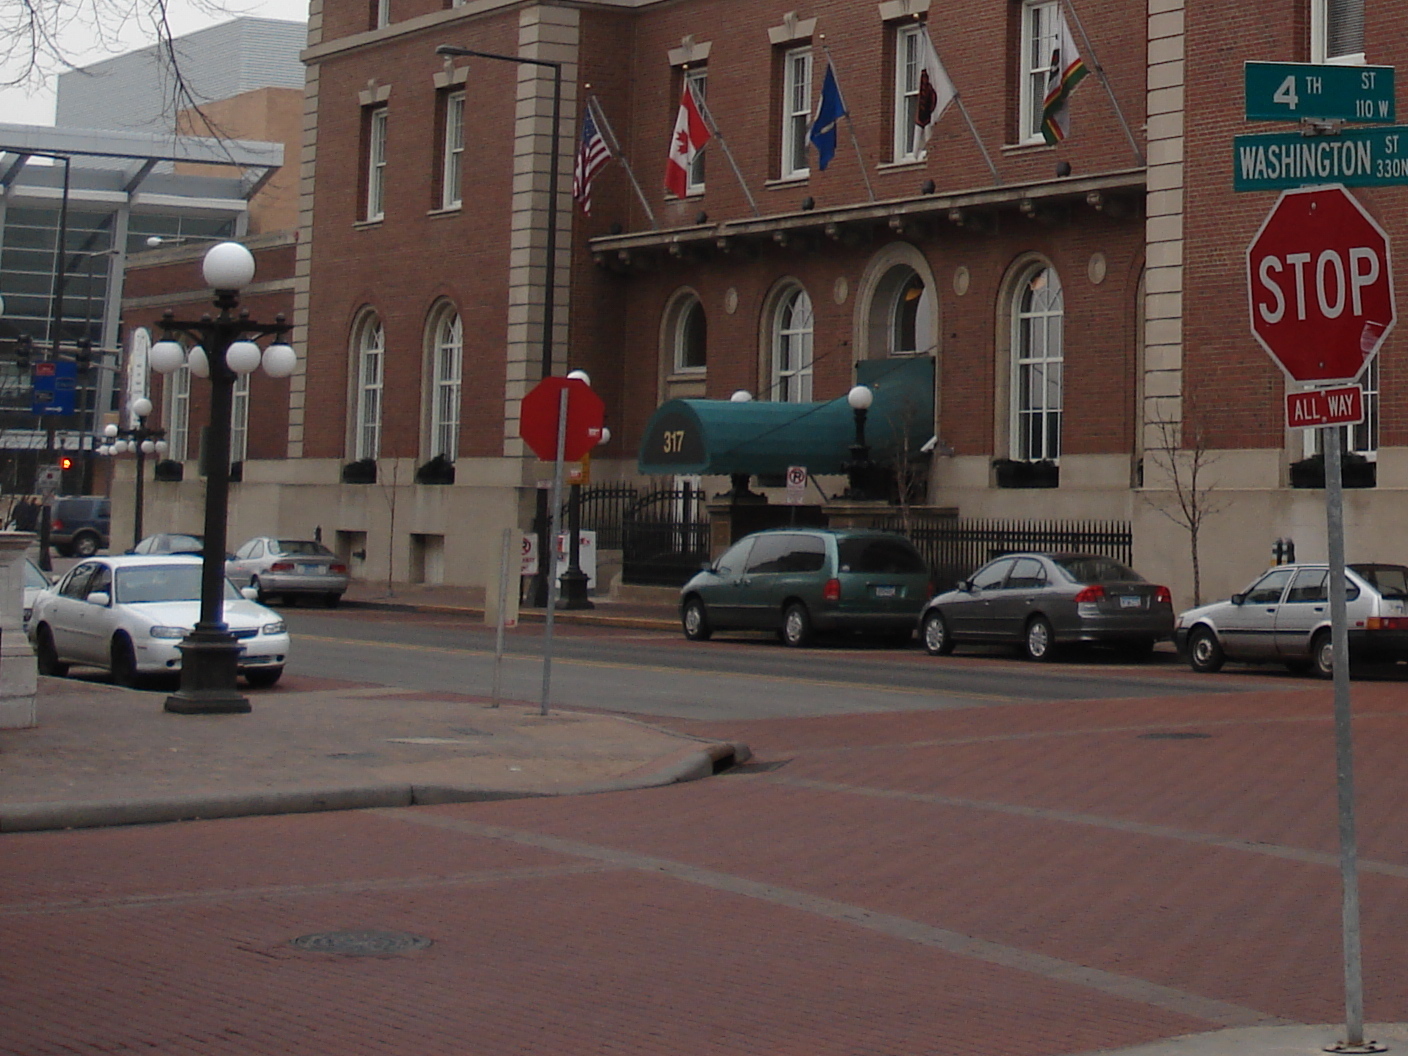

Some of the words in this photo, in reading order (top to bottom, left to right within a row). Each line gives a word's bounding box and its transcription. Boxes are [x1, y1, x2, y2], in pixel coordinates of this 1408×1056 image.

[1361, 72, 1376, 90] ST
[1356, 100, 1374, 118] 110
[1379, 100, 1389, 118] W
[1385, 135, 1399, 154] ST
[1240, 140, 1371, 180] WASHINGTON
[1259, 247, 1380, 324] STOP
[1294, 398, 1321, 421] ALL
[1328, 393, 1354, 417] WAY
[663, 430, 685, 453] 317
